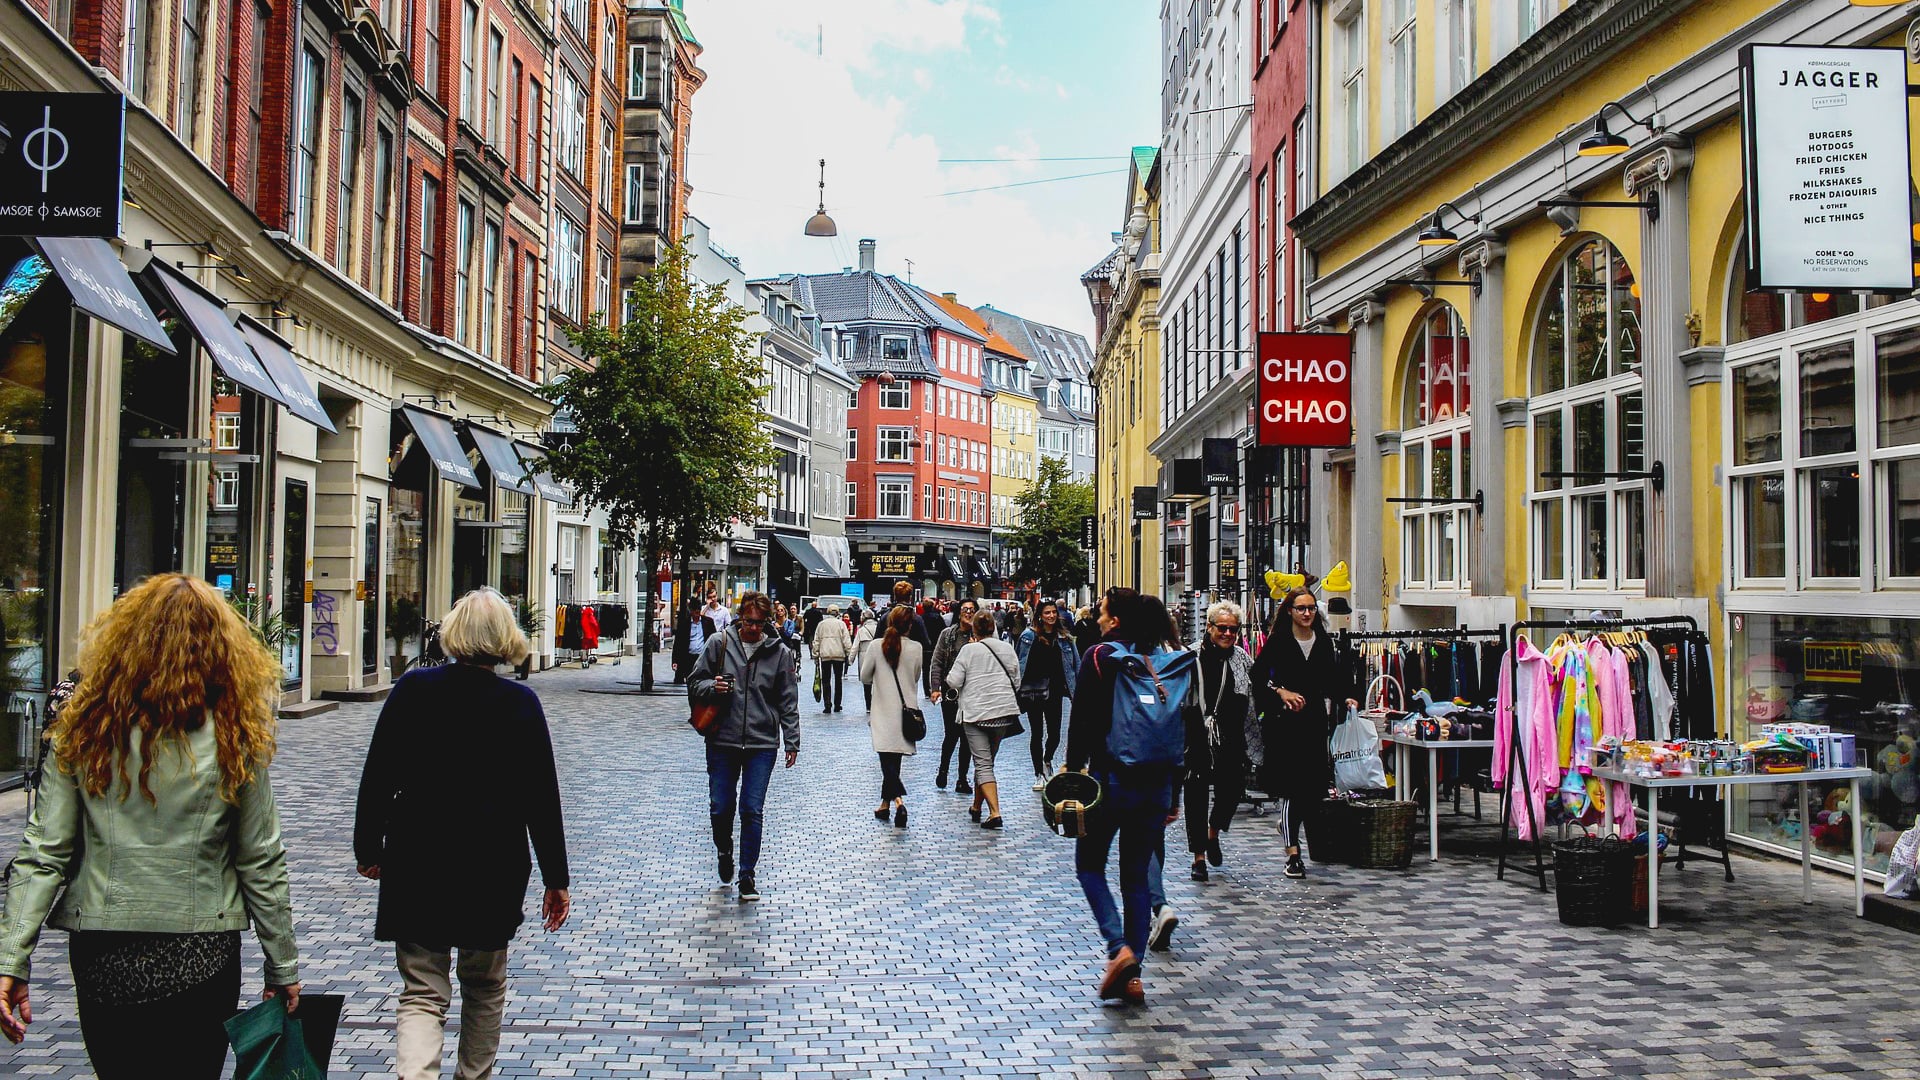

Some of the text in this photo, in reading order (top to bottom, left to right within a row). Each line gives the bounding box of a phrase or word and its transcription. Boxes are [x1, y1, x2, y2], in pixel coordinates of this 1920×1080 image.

[1779, 70, 1879, 88] JAGGER
[1808, 130, 1853, 140] BURGERS
[1808, 142, 1854, 152] HOTDOGS
[1796, 152, 1868, 165] FRIED CHICKEN
[1819, 166, 1846, 175] FRIES
[1803, 177, 1863, 188] MILKSHAKES
[1789, 187, 1877, 201] FROZEN DAIQUIRIS
[53, 206, 102, 218] SAMSØE
[1804, 212, 1865, 224] NICE THINGS
[1816, 258, 1869, 266] RESERVATIONS
[1263, 358, 1347, 383] CHAO
[1263, 399, 1347, 424] CHAO
[871, 555, 894, 563] PETER
[1805, 647, 1862, 671] UDSALG
